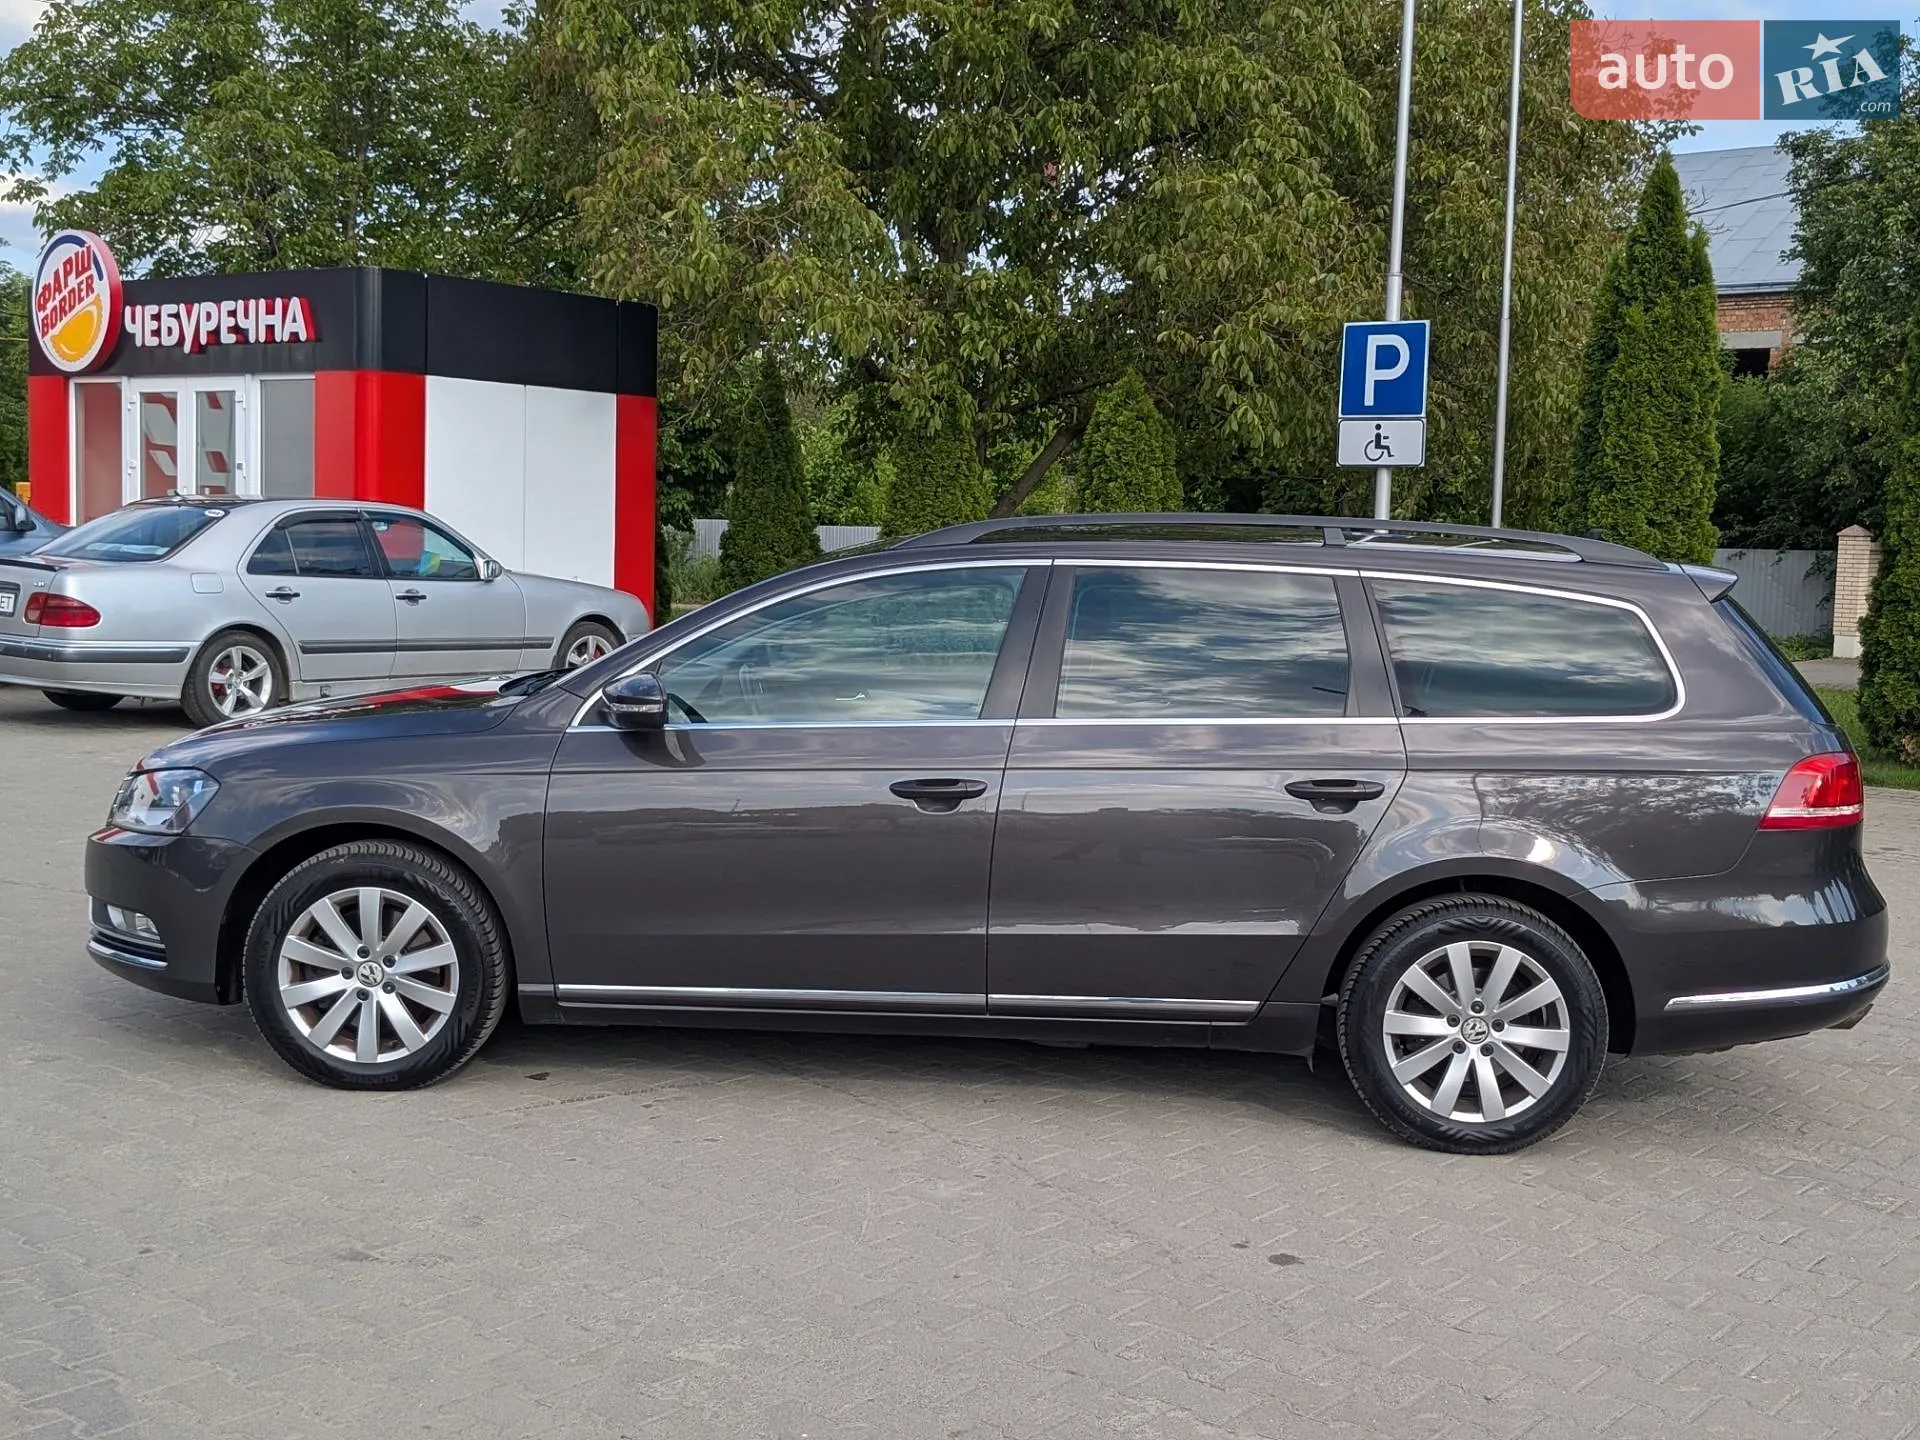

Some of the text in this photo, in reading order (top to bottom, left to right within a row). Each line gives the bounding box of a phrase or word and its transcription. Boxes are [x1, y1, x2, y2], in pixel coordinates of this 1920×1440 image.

[36, 244, 93, 314] ФАРШ
[40, 273, 96, 340] BORDER
[124, 296, 310, 354] ЧЕБУРЕЧНА
[1364, 334, 1410, 407] P
